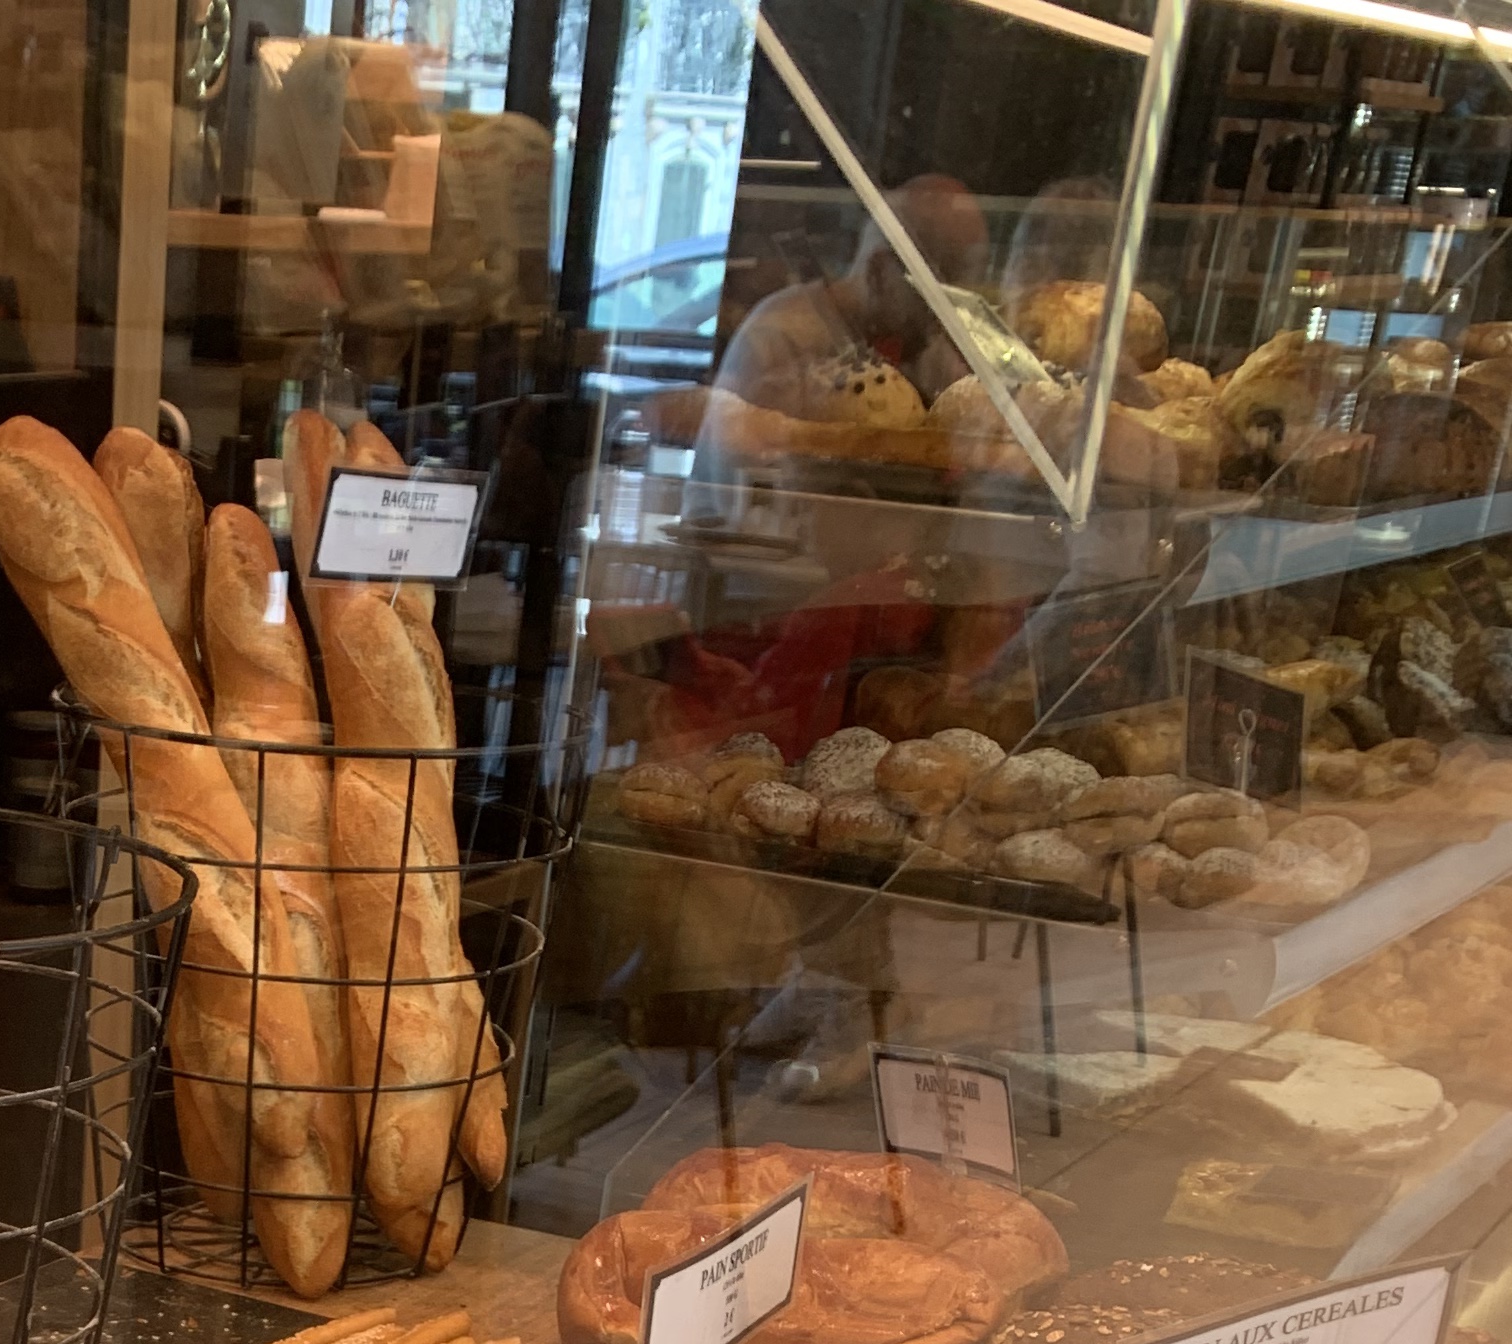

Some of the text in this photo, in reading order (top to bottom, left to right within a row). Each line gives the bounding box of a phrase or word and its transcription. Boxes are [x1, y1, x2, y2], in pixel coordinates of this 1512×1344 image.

[381, 489, 439, 512] BAGUETTE
[700, 1255, 728, 1291] PAIN
[728, 1228, 770, 1271] SPORTIF
[1282, 1286, 1405, 1335] CEREALES
